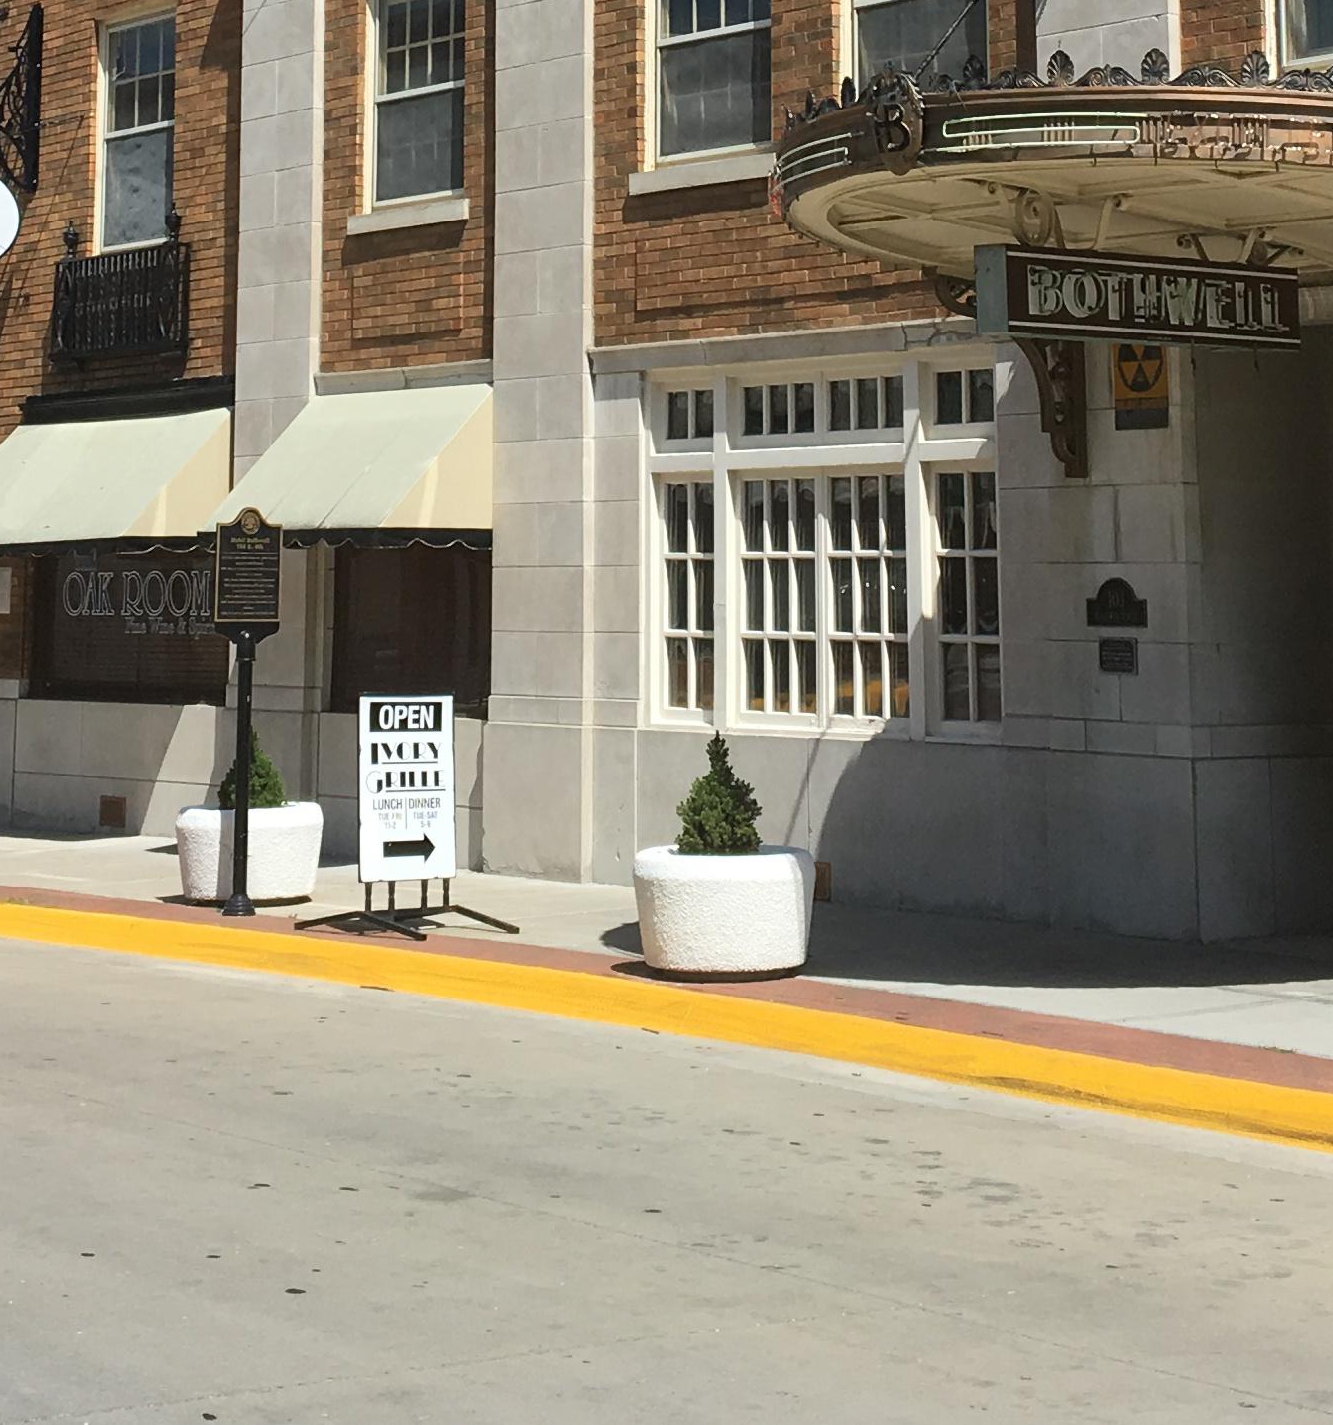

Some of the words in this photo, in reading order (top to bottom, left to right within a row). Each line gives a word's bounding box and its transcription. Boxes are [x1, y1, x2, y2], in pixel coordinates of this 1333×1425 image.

[1027, 264, 1290, 331] BOTHWELL
[63, 572, 115, 616] OAK
[121, 570, 211, 616] ROOM
[379, 705, 435, 730] OPEN
[371, 742, 442, 765] IVORY
[366, 770, 447, 794] GRILLE
[372, 798, 403, 811] LUNCH
[409, 797, 441, 809] DINNER
